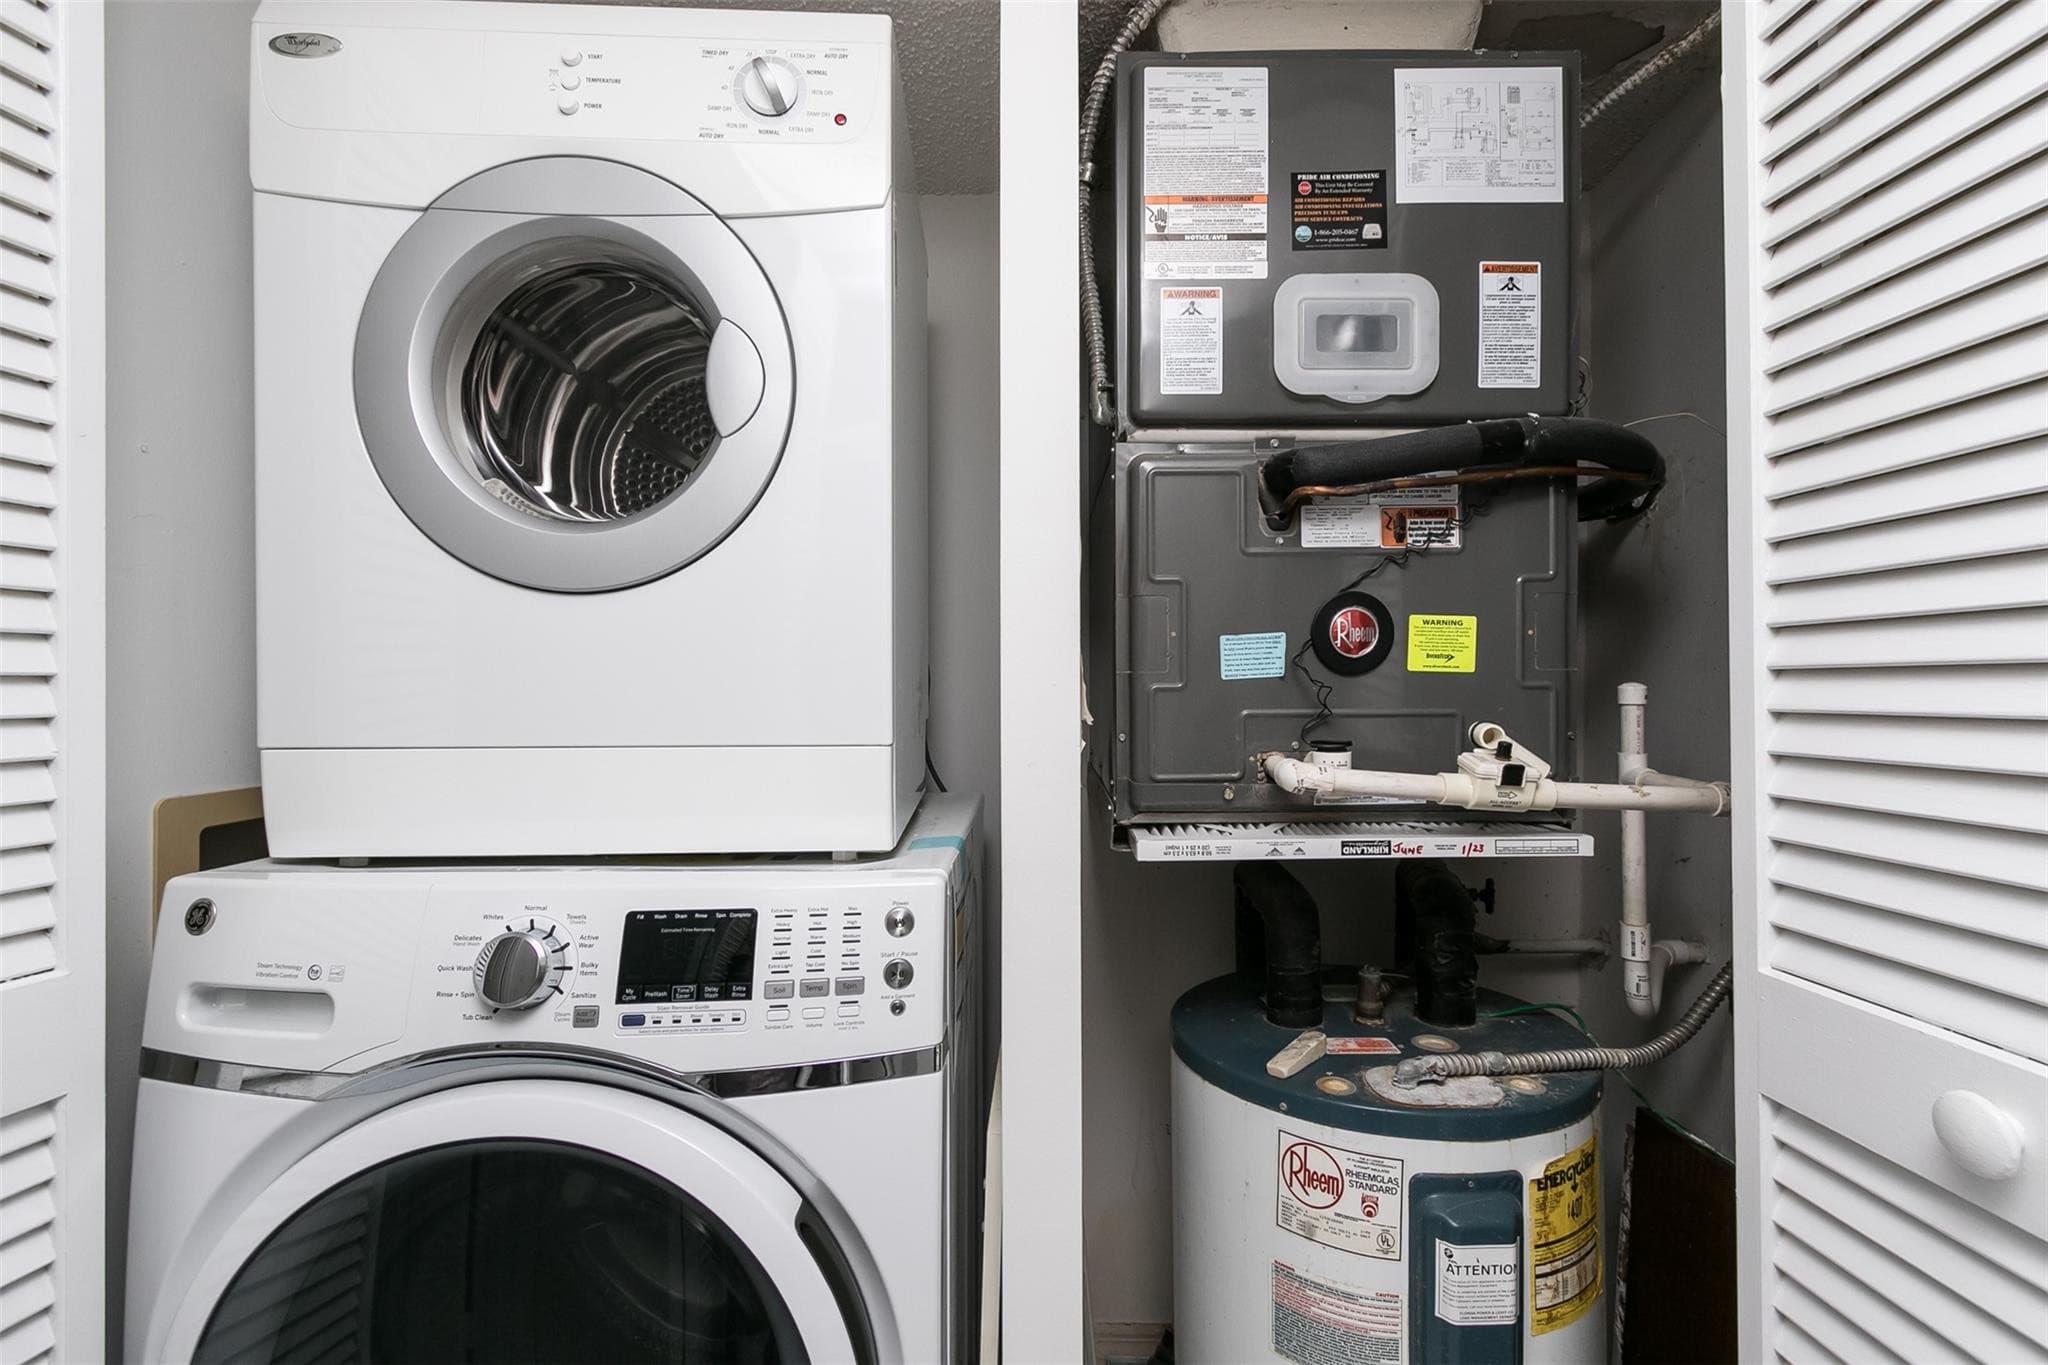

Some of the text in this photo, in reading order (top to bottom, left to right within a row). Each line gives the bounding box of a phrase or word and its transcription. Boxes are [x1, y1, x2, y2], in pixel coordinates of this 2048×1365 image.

[287, 38, 321, 47] Whirlpool
[1332, 172, 1380, 180] CONDITIONING
[1173, 289, 1217, 298] WARNING
[1334, 611, 1376, 649] Rheem
[1342, 846, 1390, 854] KIRKLAND
[1392, 842, 1424, 855] JUNE
[1462, 842, 1484, 857] 1/23
[274, 963, 303, 972] Technology
[437, 964, 455, 972] Quick
[279, 972, 299, 980] Control
[1289, 1146, 1341, 1200] Rheem
[1348, 1180, 1398, 1196] STANDARD
[1375, 1291, 1400, 1299] CAUTION
